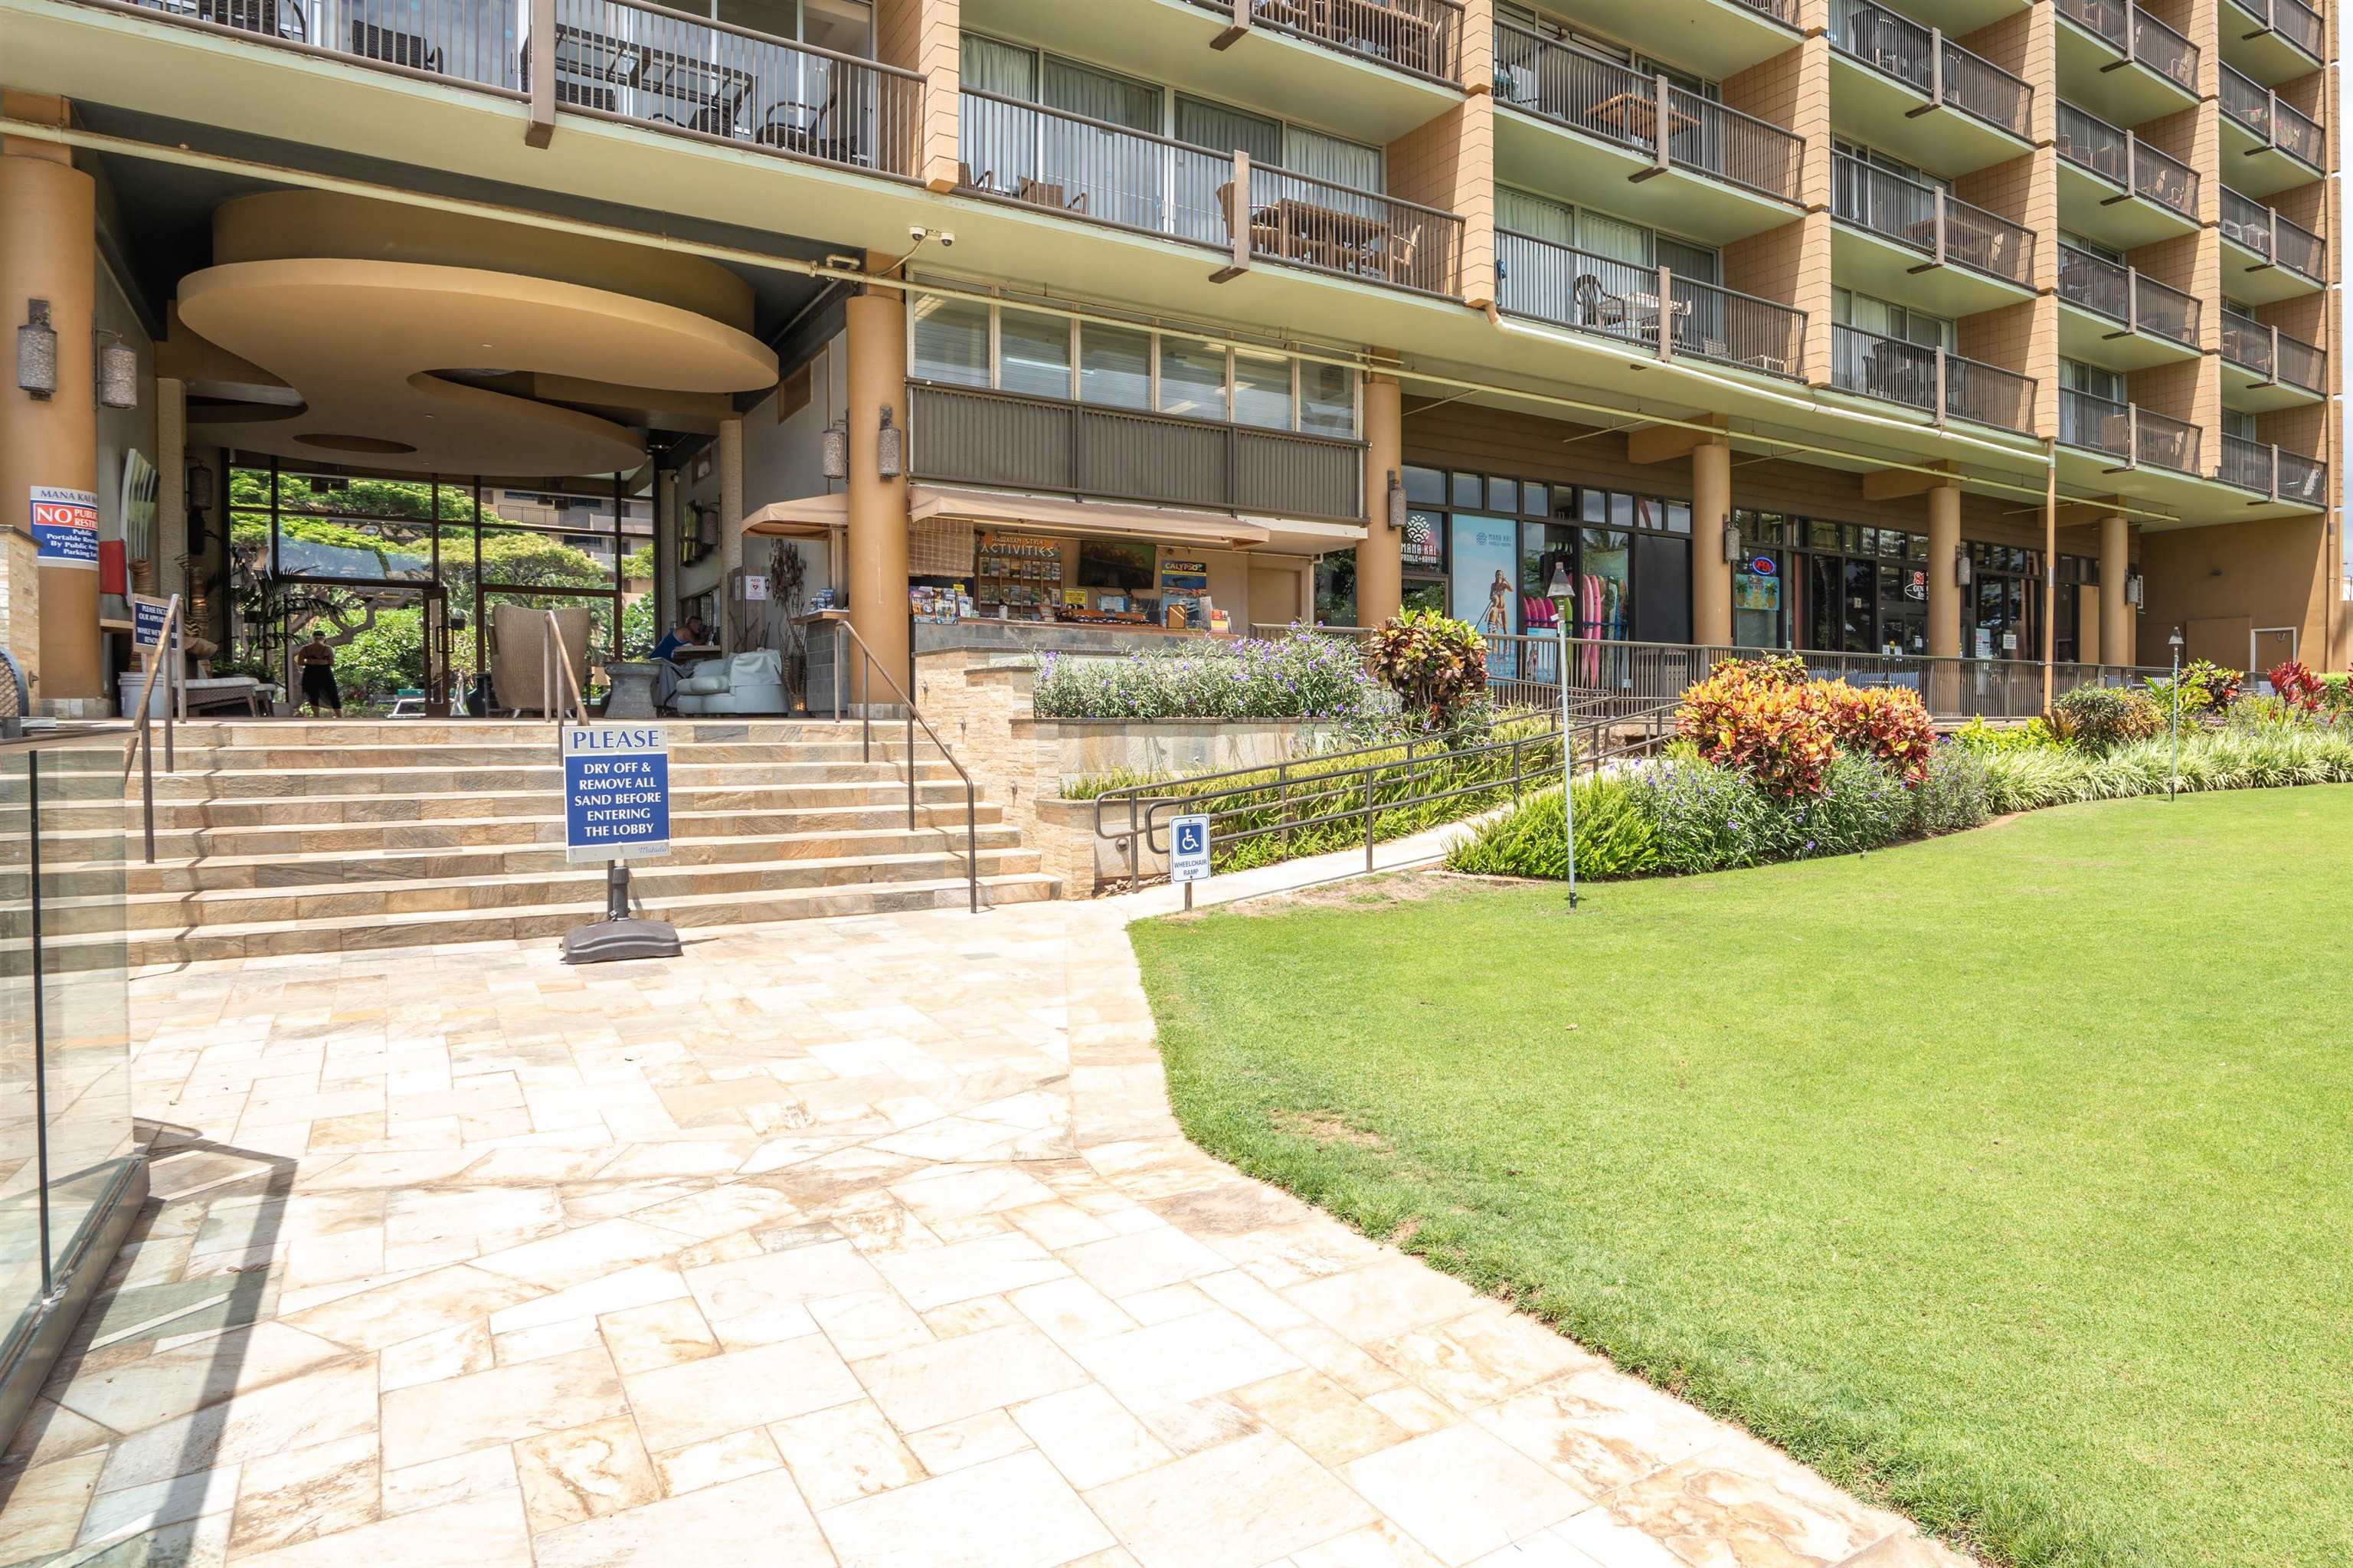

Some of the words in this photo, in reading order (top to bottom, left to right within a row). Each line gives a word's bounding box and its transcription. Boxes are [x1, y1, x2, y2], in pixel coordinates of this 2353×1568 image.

[40, 490, 75, 500] MANA
[36, 506, 73, 523] NO
[47, 533, 81, 542] Portable
[64, 542, 88, 550] Public
[980, 543, 1055, 557] ACTIVITIES
[1401, 543, 1422, 555] MANA
[1424, 545, 1436, 555] KAI
[63, 548, 90, 558] Parking
[1164, 562, 1198, 571] CALYPSO
[573, 730, 659, 749] PLEASE
[584, 763, 610, 774] DRY
[614, 762, 638, 774] OFF
[641, 761, 651, 772] &
[579, 777, 632, 791] REMOVE
[635, 777, 656, 788] ALL
[574, 794, 611, 807] SAND
[615, 792, 662, 804] BEFORE
[587, 807, 650, 822] ENTERING
[584, 826, 610, 837] THE
[613, 823, 654, 836] LOBBY
[1174, 859, 1207, 869] WHEELCHAIR
